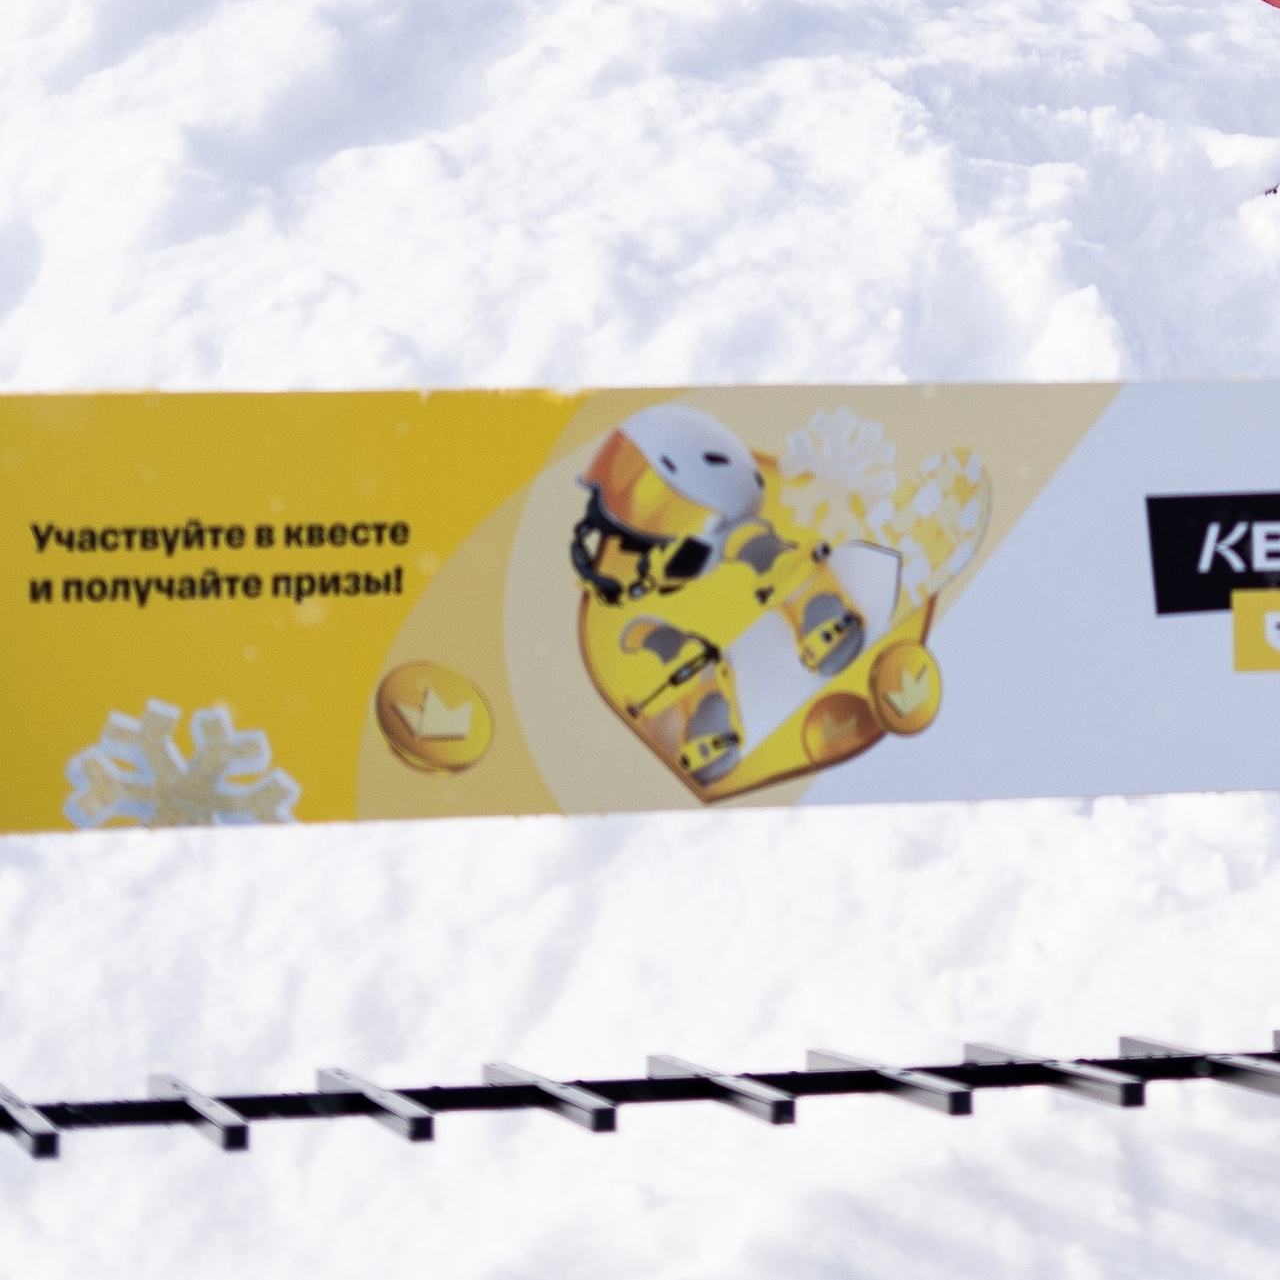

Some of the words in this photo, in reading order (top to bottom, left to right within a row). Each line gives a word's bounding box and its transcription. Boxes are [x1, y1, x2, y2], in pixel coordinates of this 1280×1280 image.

[30, 518, 246, 558] Участвуйте
[254, 523, 275, 548] в
[284, 520, 410, 548] квесте
[29, 577, 53, 604] и
[62, 568, 263, 609] получайте
[272, 564, 404, 605] призы!
